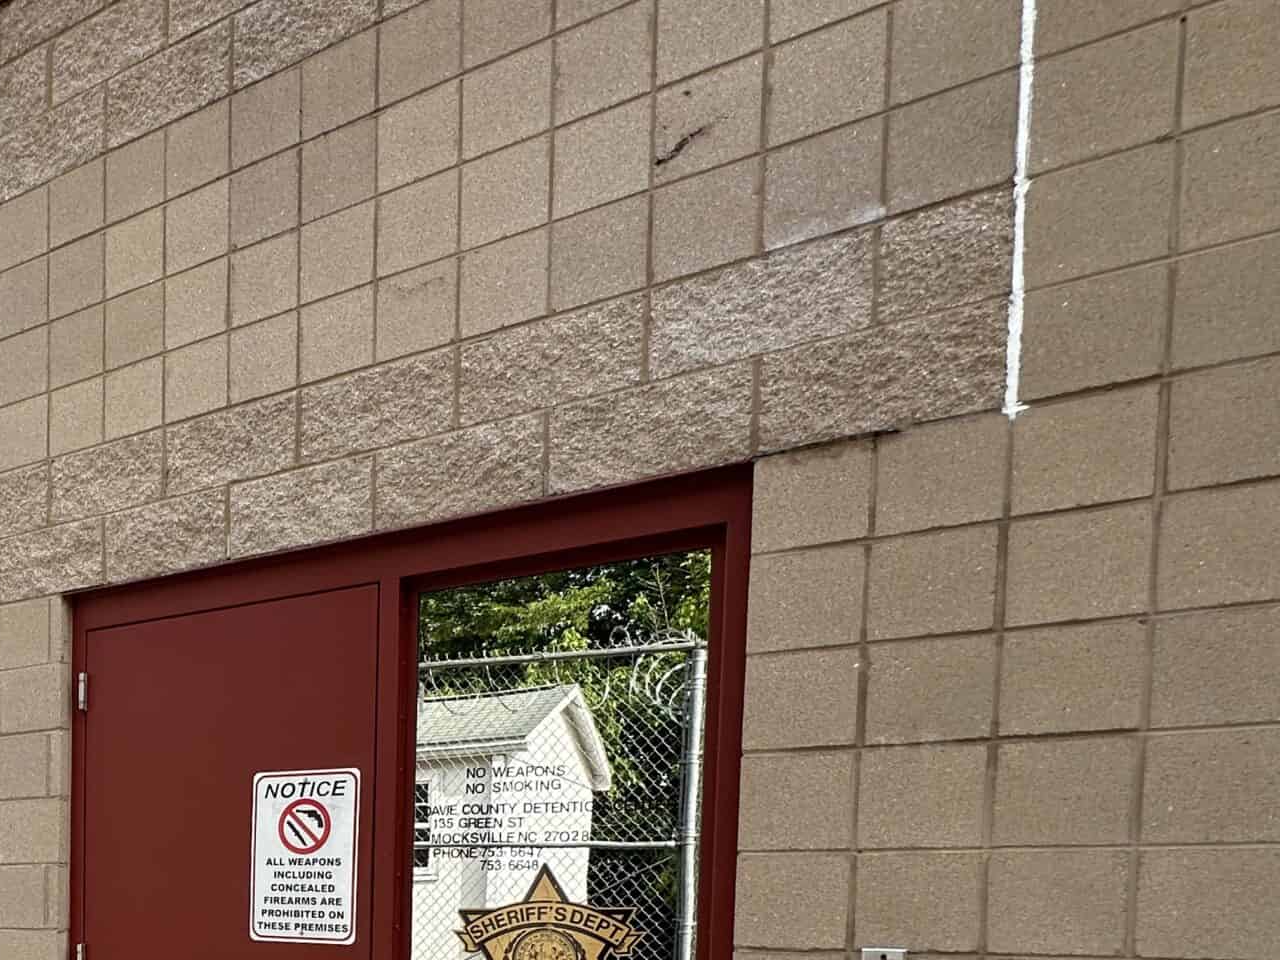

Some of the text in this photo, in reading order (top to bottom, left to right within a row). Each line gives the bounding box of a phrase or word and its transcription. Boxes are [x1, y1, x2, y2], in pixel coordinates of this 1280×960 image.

[466, 765, 566, 778] NO WEAPONS
[264, 780, 348, 799] NOTICE
[465, 779, 562, 794] NO SMOKING
[462, 803, 518, 815] COUNTY
[433, 817, 525, 829] 135 GREEN ST
[431, 831, 515, 845] MOCKSVILLE
[518, 831, 537, 843] NC
[265, 858, 342, 866] ALL WEAPONS
[273, 871, 333, 879] INCLUDING
[271, 884, 335, 893] CONCEALED
[263, 896, 343, 906] FIREARMS ARE
[261, 909, 345, 919] PROHIBITED ON
[257, 921, 349, 933] THESE PREMISES
[470, 906, 625, 943] SHERIFF'S DEPT.
